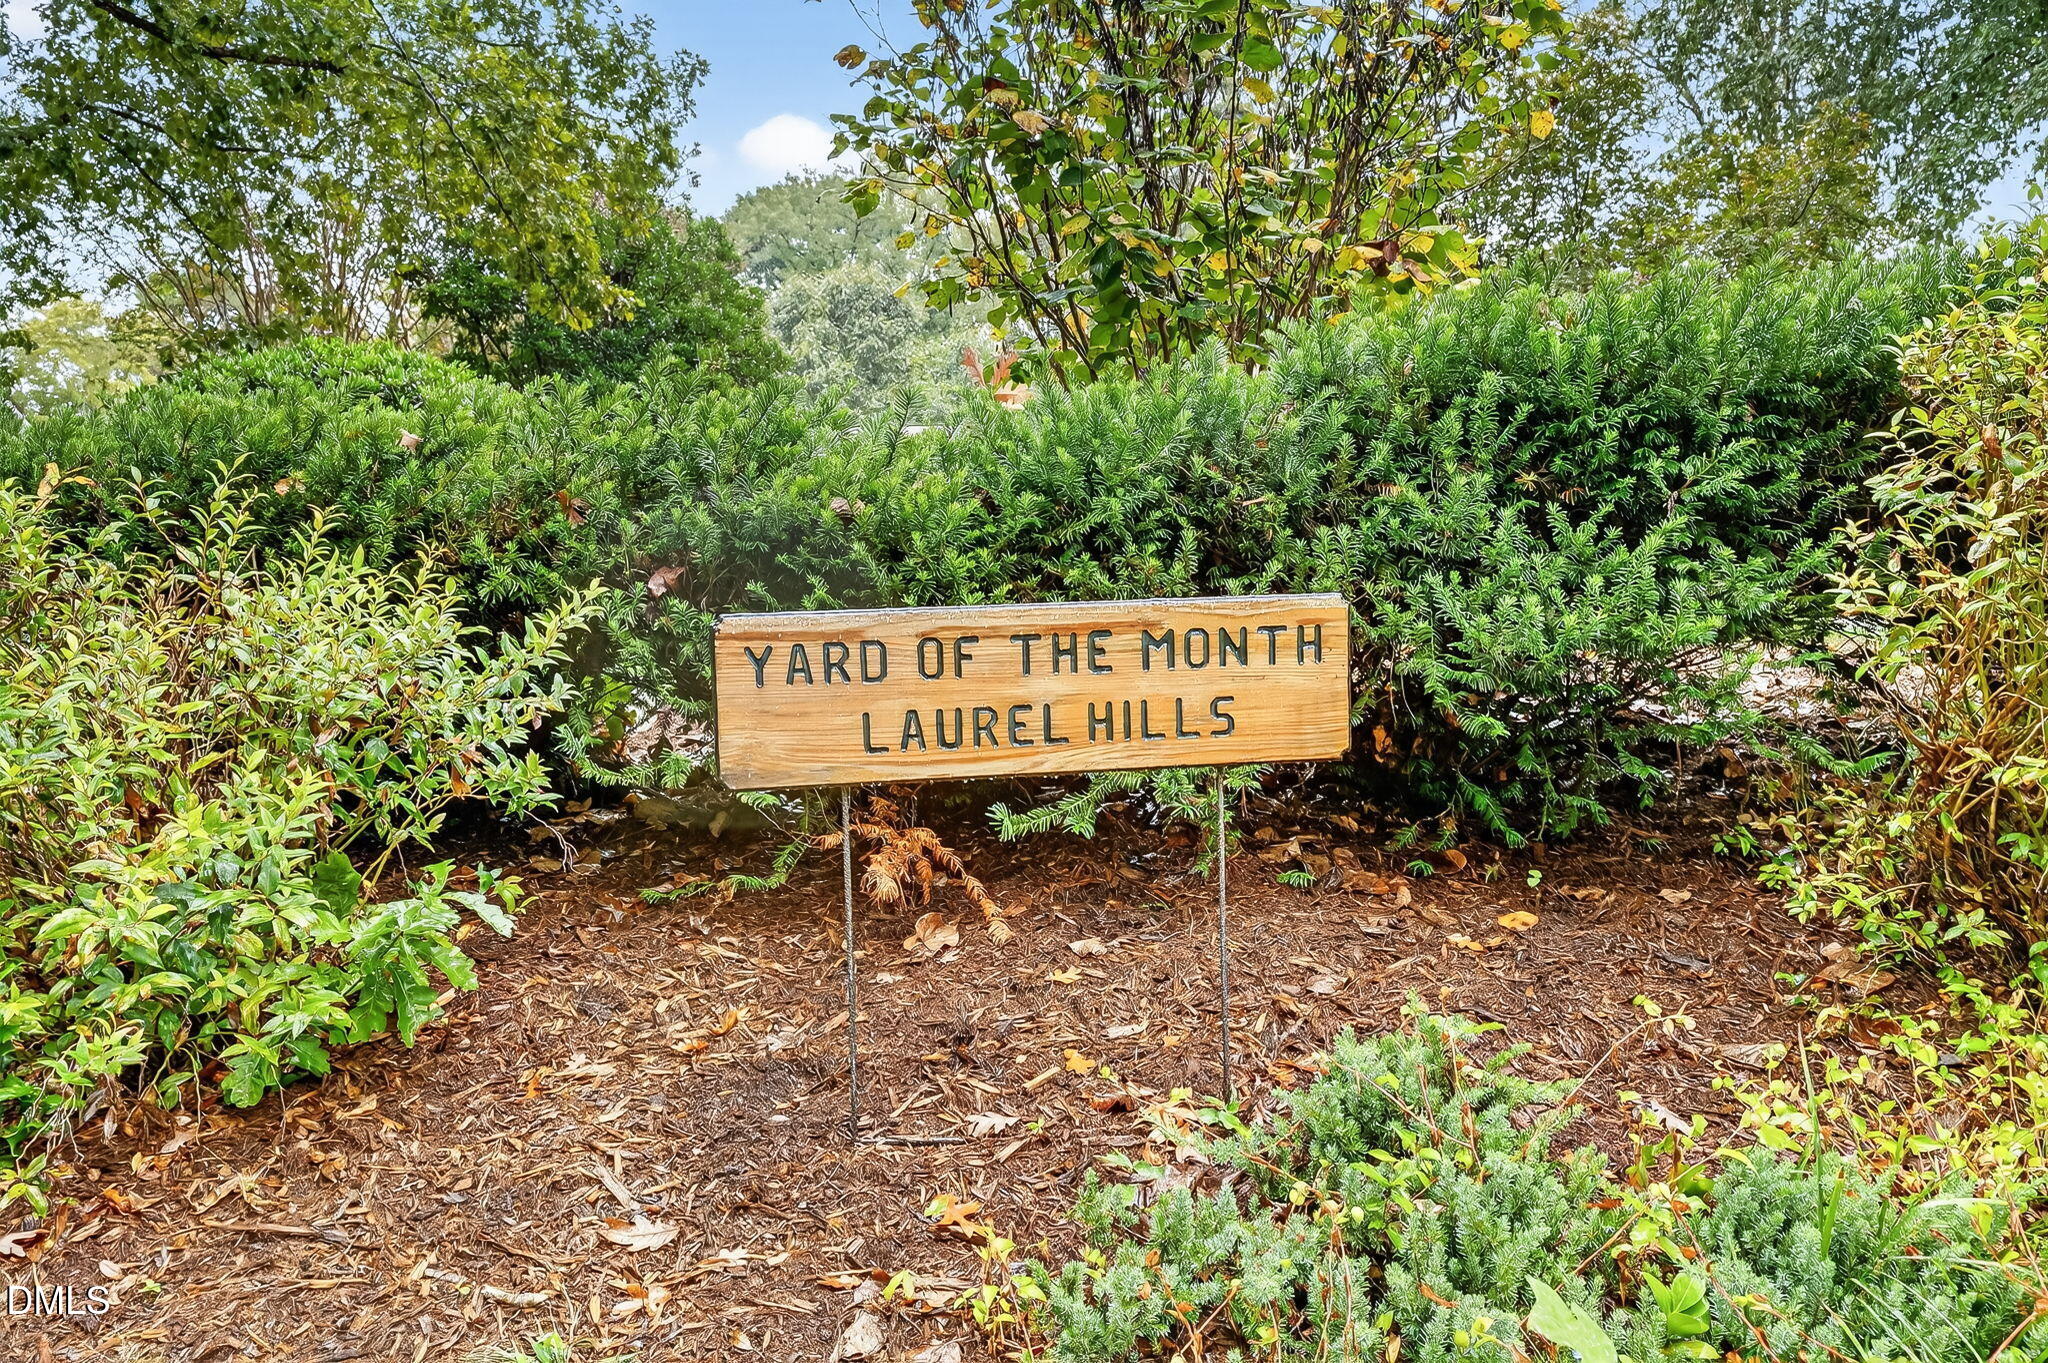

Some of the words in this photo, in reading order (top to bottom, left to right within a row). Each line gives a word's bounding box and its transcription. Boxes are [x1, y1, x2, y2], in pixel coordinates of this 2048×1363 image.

[744, 639, 888, 689] YARD
[916, 635, 979, 681] OF
[1010, 630, 1114, 677] THE
[1141, 624, 1324, 671] MONTH
[863, 703, 1070, 754] LAUREL
[1087, 695, 1236, 743] HILLS
